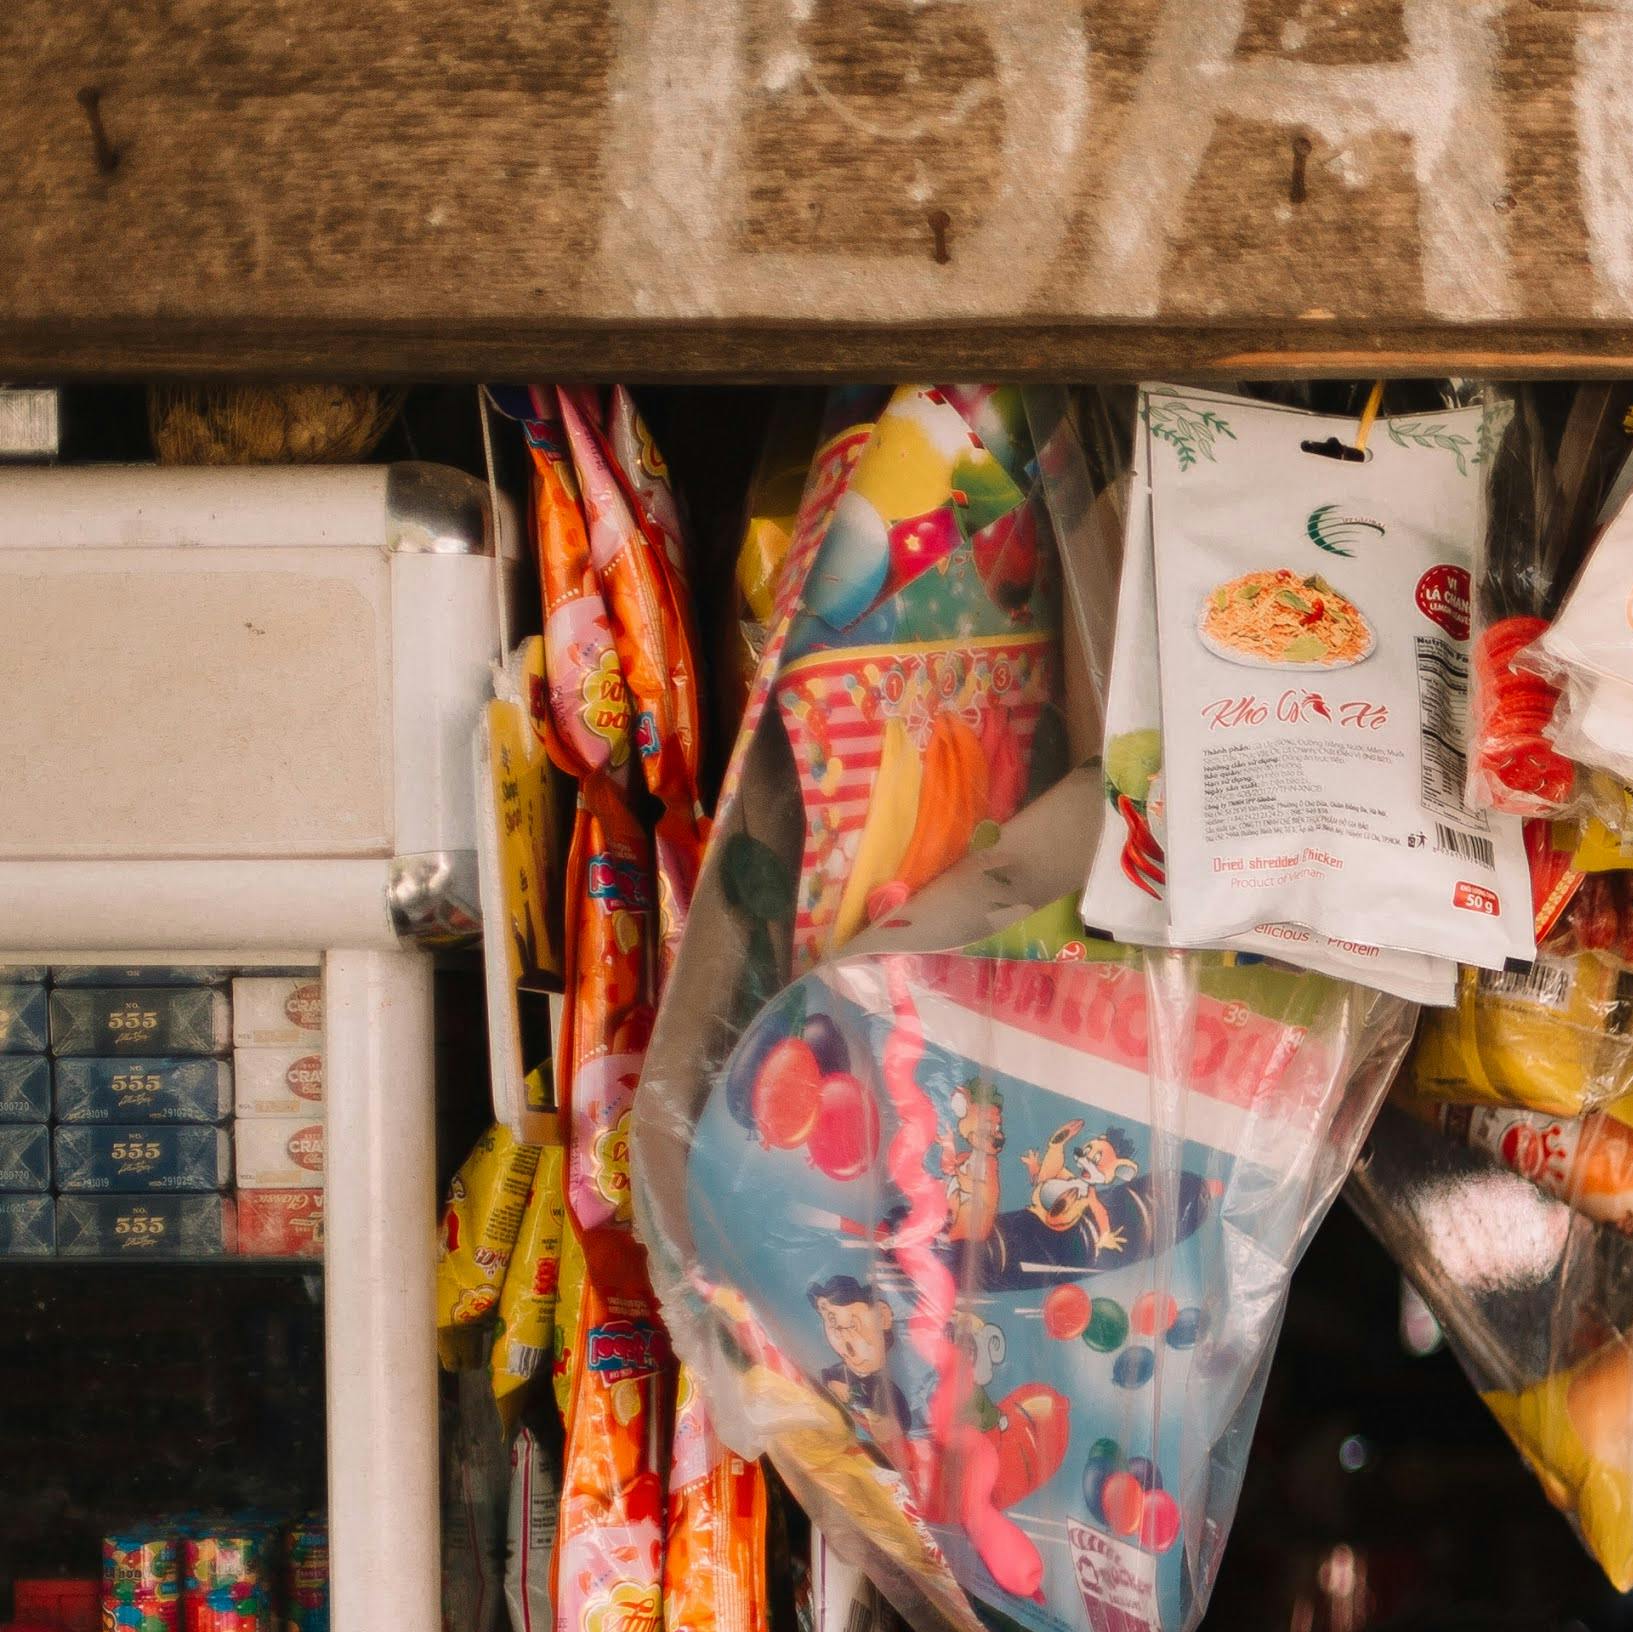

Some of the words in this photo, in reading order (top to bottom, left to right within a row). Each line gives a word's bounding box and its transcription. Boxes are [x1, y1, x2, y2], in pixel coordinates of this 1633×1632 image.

[1201, 696, 1268, 731] Khô
[1214, 857, 1244, 872] Dried
[1249, 855, 1299, 869] shredded
[1303, 848, 1344, 868] Chicken
[1231, 874, 1274, 888] Product
[1277, 873, 1287, 881] of
[1466, 894, 1483, 908] 50
[1484, 900, 1493, 914] g
[1254, 924, 1310, 942] elicious
[107, 1012, 158, 1029] 555
[111, 1075, 162, 1091] 555
[111, 1142, 162, 1159] 555
[114, 1216, 165, 1234] 555
